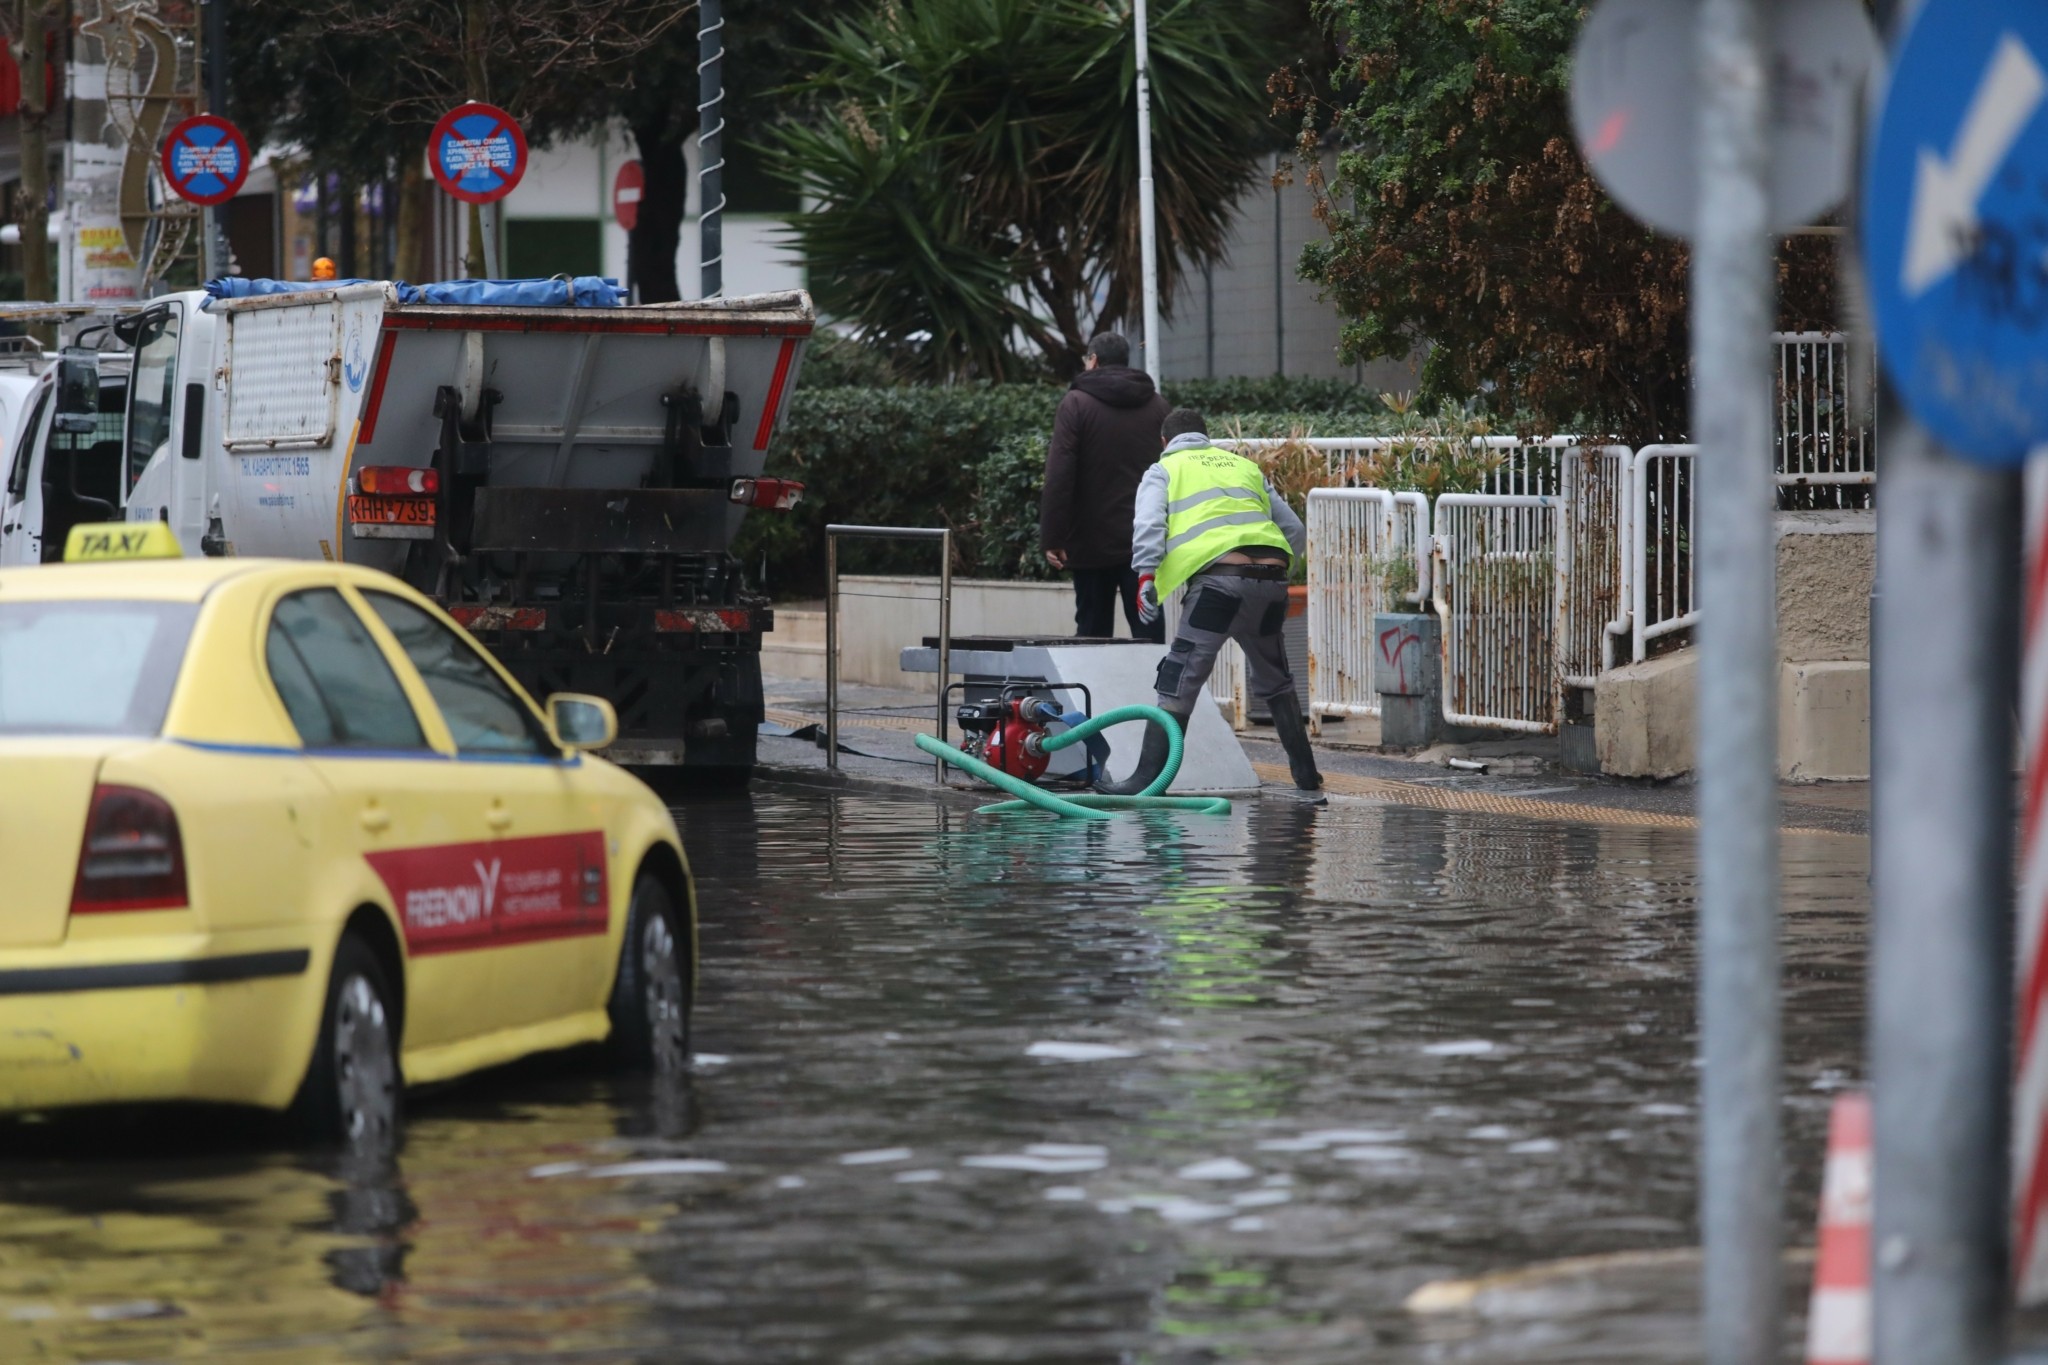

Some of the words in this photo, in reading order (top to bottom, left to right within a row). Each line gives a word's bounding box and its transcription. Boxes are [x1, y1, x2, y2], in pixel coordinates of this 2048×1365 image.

[1187, 454, 1239, 462] ΠΕΡΦΕΡΕΙΑ
[1201, 460, 1236, 468] ΑΤΙΚΗΣ
[292, 456, 310, 476] 1565
[81, 530, 149, 555] TAXI
